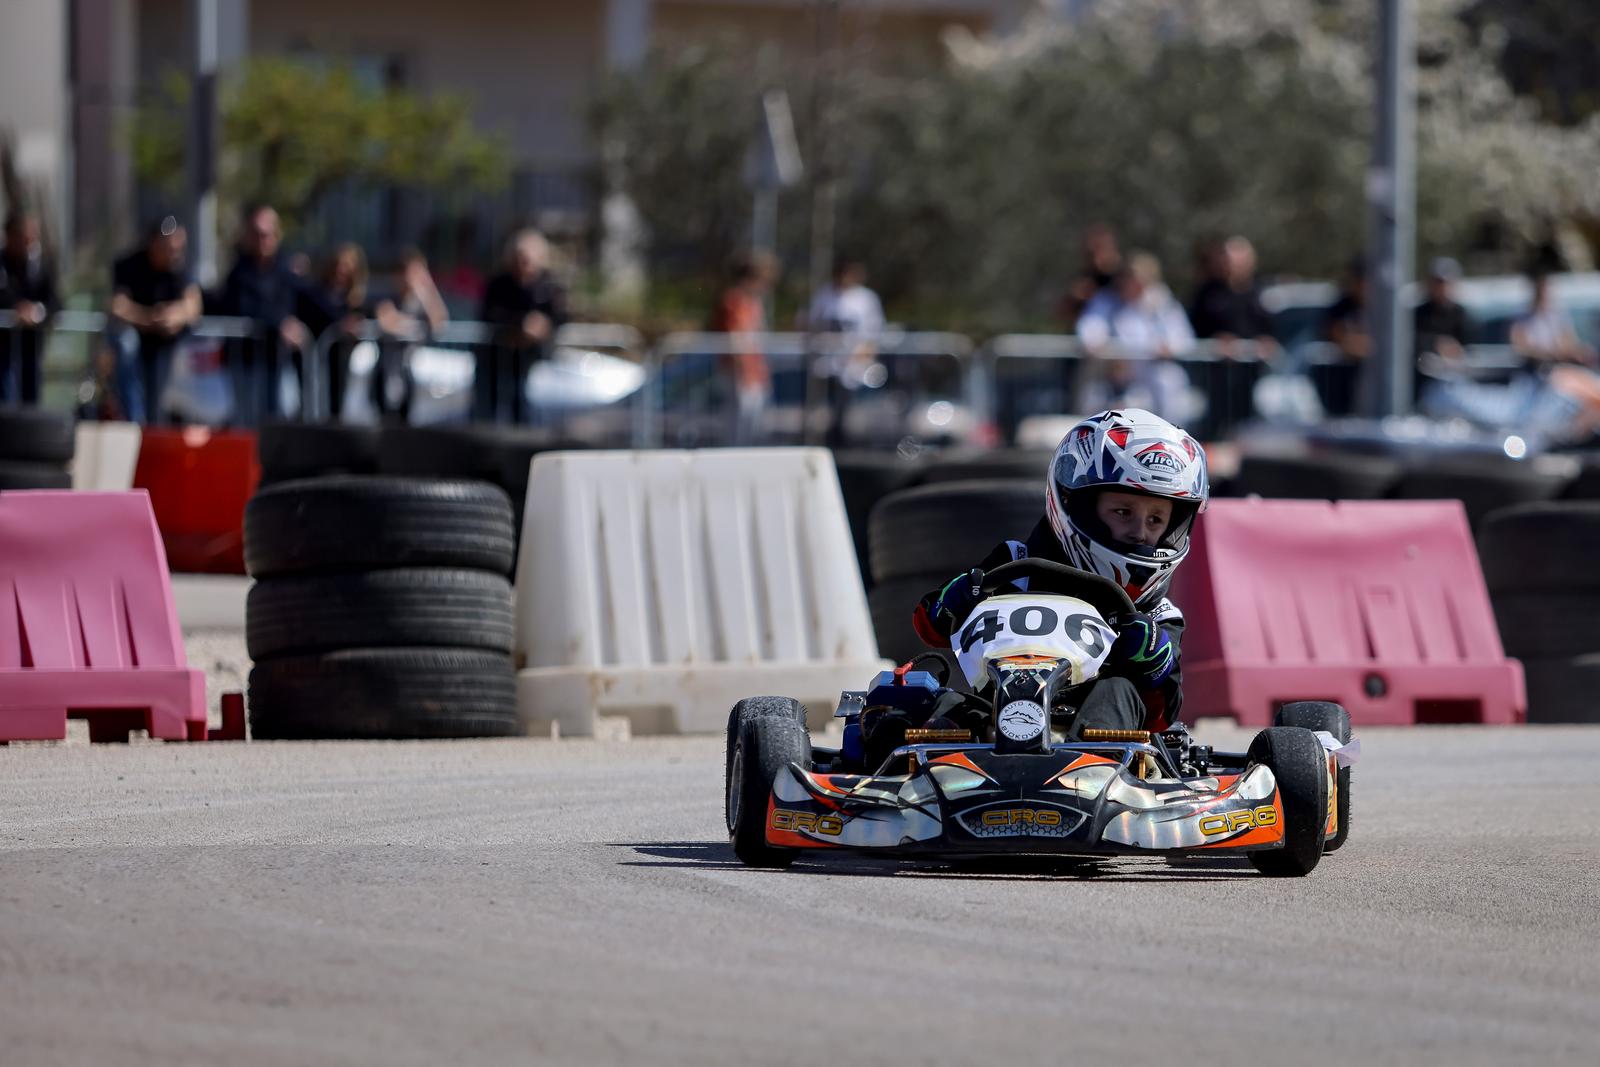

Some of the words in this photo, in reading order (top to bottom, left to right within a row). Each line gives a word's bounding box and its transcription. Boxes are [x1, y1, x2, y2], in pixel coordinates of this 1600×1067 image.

[1142, 453, 1181, 471] Airoh
[960, 606, 1109, 658] 406
[1004, 702, 1023, 713] AUTO
[1028, 703, 1043, 718] KLUB
[1001, 725, 1040, 739] BIOKOVO
[772, 809, 843, 836] CRG
[982, 809, 1061, 826] CRG
[1199, 805, 1277, 836] CRG
